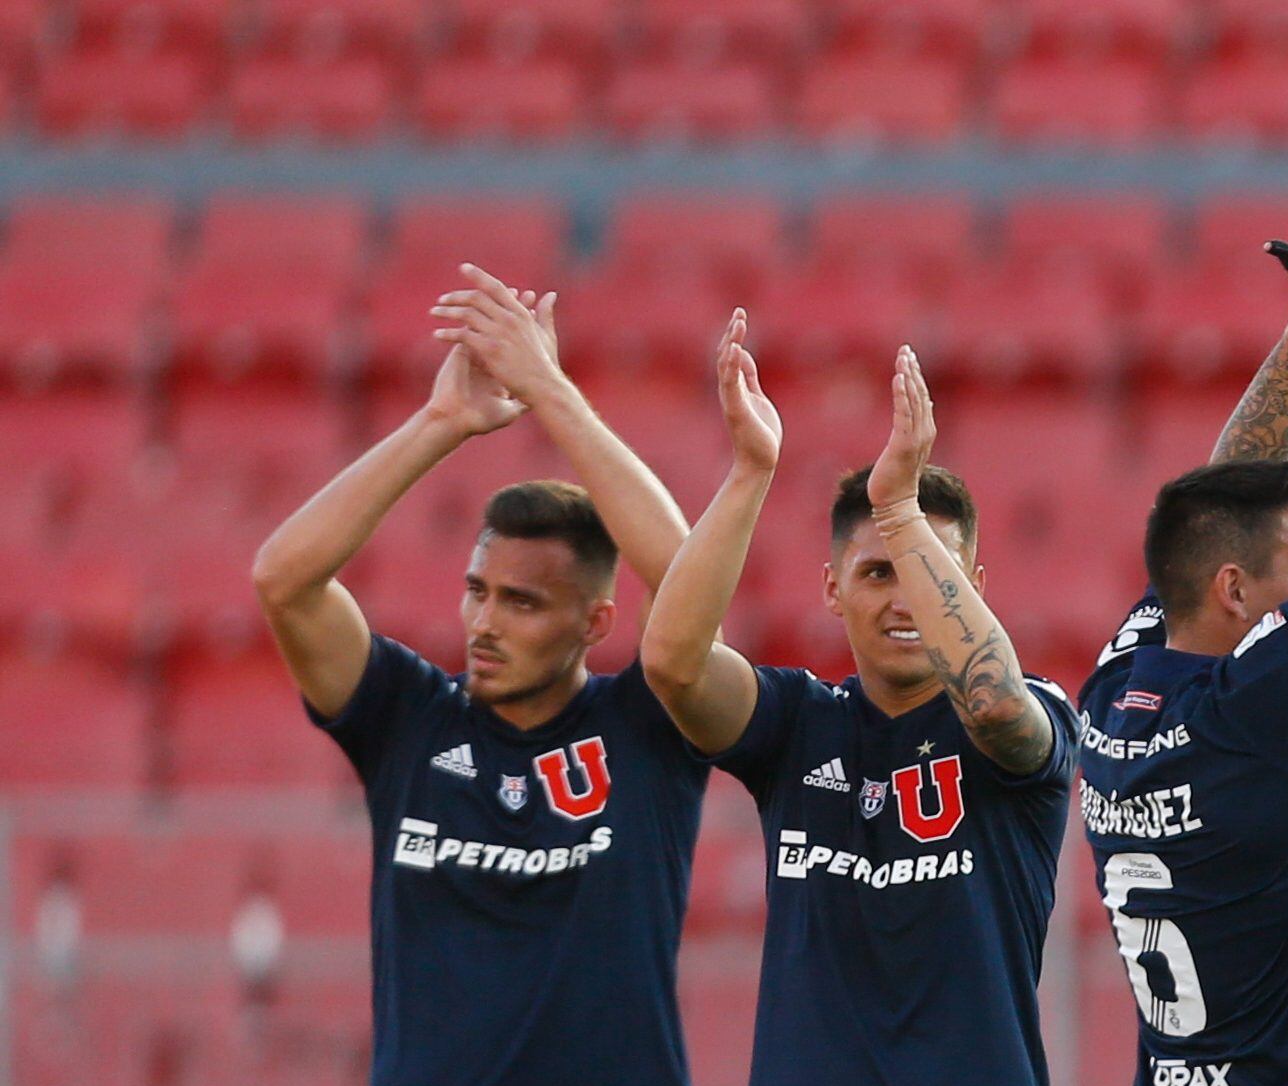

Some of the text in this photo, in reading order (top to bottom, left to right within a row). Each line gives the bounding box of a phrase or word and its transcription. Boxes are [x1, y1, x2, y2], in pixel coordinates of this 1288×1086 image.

[430, 756, 478, 779] adidas
[533, 735, 612, 821] U
[803, 775, 850, 793] adidas
[892, 754, 965, 843] U
[1103, 852, 1208, 1038] 6
